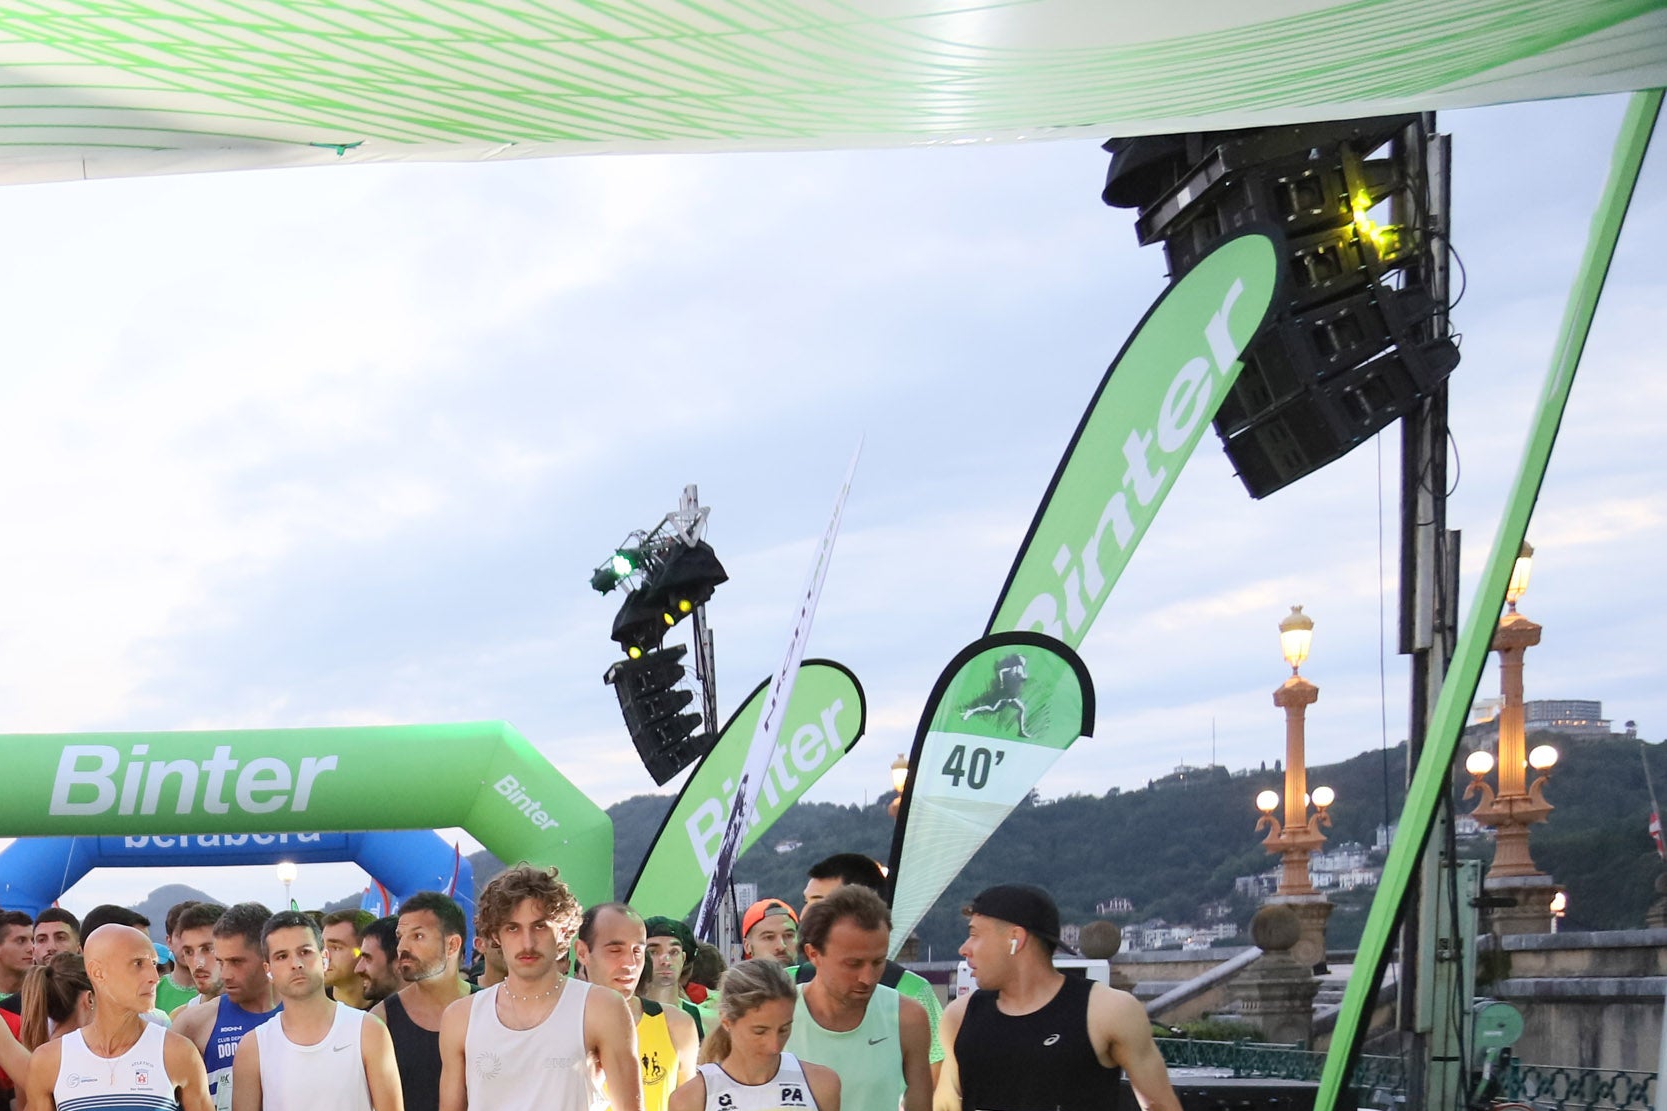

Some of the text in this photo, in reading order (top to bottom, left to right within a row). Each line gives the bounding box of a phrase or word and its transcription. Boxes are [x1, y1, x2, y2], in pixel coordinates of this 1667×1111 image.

[48, 745, 339, 816] Binter
[492, 773, 559, 833] Binter
[781, 1088, 803, 1102] PA
